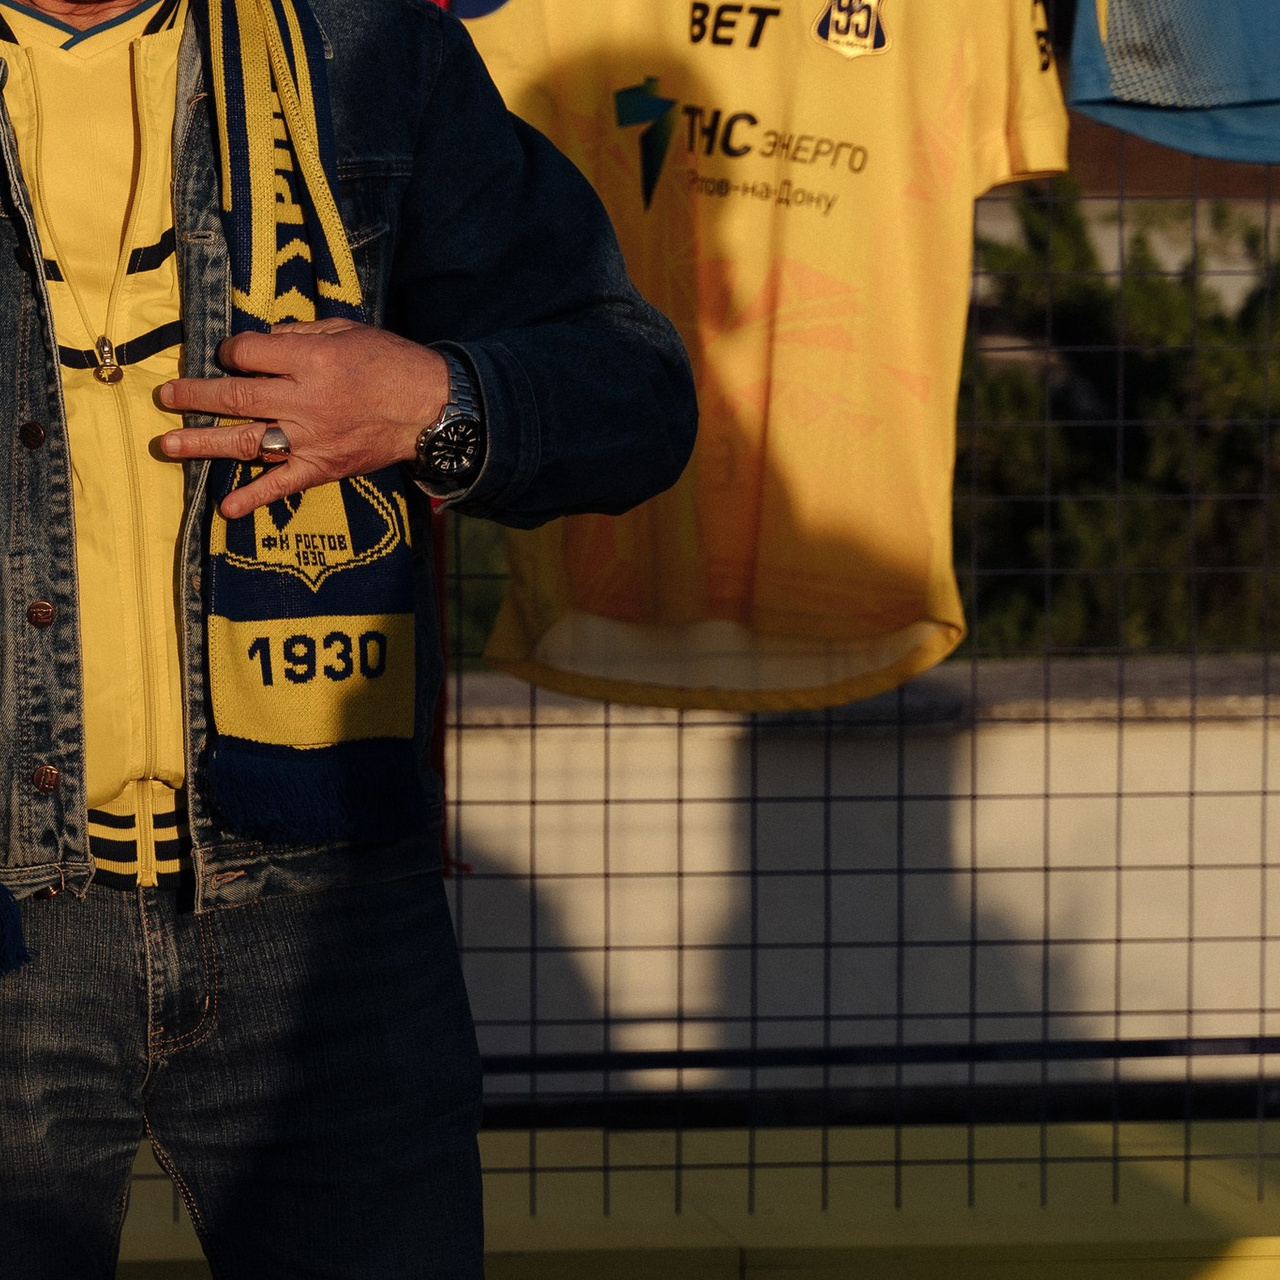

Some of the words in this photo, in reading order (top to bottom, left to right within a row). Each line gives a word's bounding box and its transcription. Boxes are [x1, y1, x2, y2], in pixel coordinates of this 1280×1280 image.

[690, 2, 780, 48] BET
[682, 105, 758, 158] ТНС
[295, 533, 348, 551] РОСТОВ
[295, 551, 328, 566] 1930
[248, 631, 387, 686] 1930
